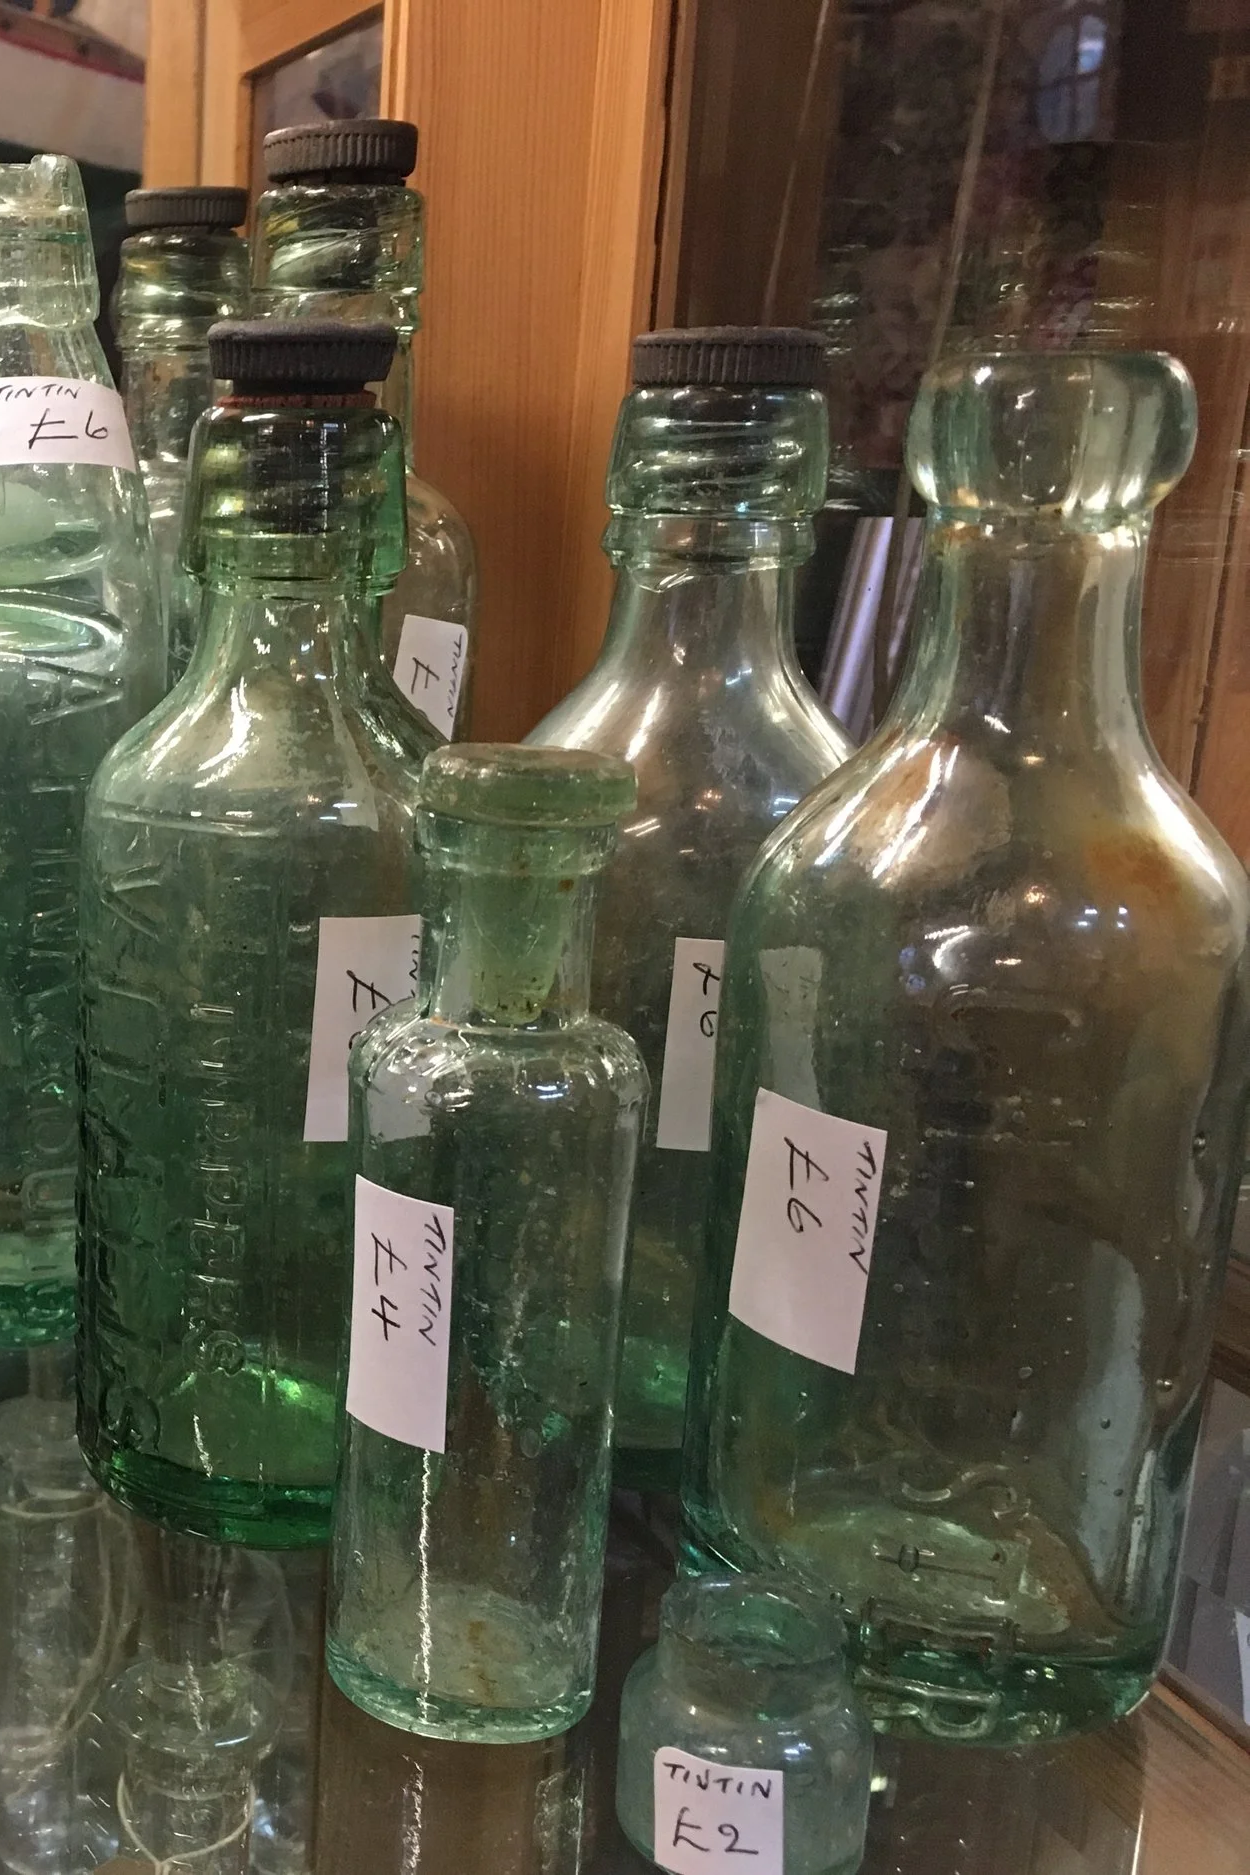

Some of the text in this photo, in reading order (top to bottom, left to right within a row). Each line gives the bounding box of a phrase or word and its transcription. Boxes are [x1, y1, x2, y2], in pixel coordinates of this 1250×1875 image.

[28, 407, 108, 449] £6
[783, 1136, 830, 1234] £6
[849, 1141, 877, 1276] TINTIN
[370, 1231, 408, 1342] £4
[418, 1213, 447, 1347] TINTIN
[672, 1806, 760, 1856] £2
